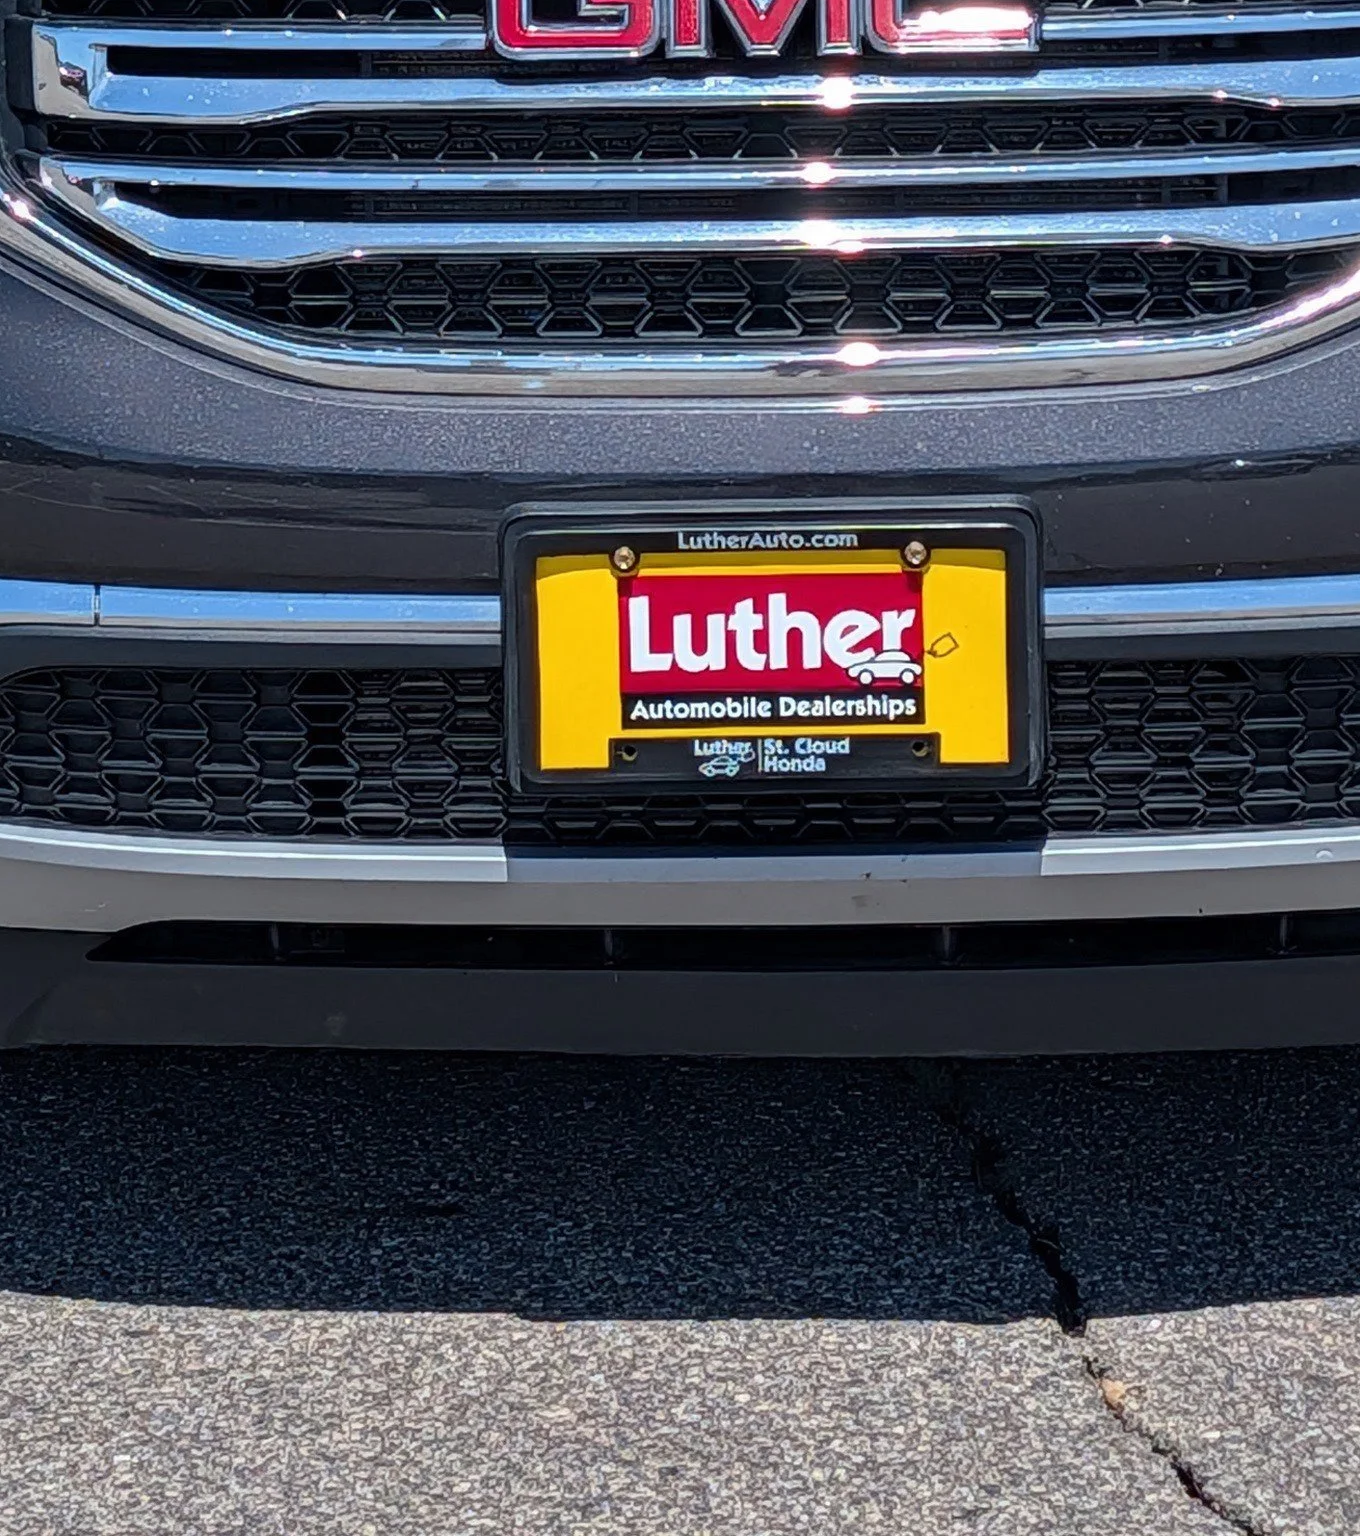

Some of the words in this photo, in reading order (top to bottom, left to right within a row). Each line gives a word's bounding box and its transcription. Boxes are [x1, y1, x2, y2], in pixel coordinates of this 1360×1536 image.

[677, 530, 859, 550] LutherAuto.com
[628, 592, 917, 673] Luther
[629, 697, 772, 721] Automobile
[779, 694, 917, 720] Dealerships
[763, 737, 790, 755] St.
[794, 736, 851, 755] Cloud
[763, 755, 827, 773] Honda
